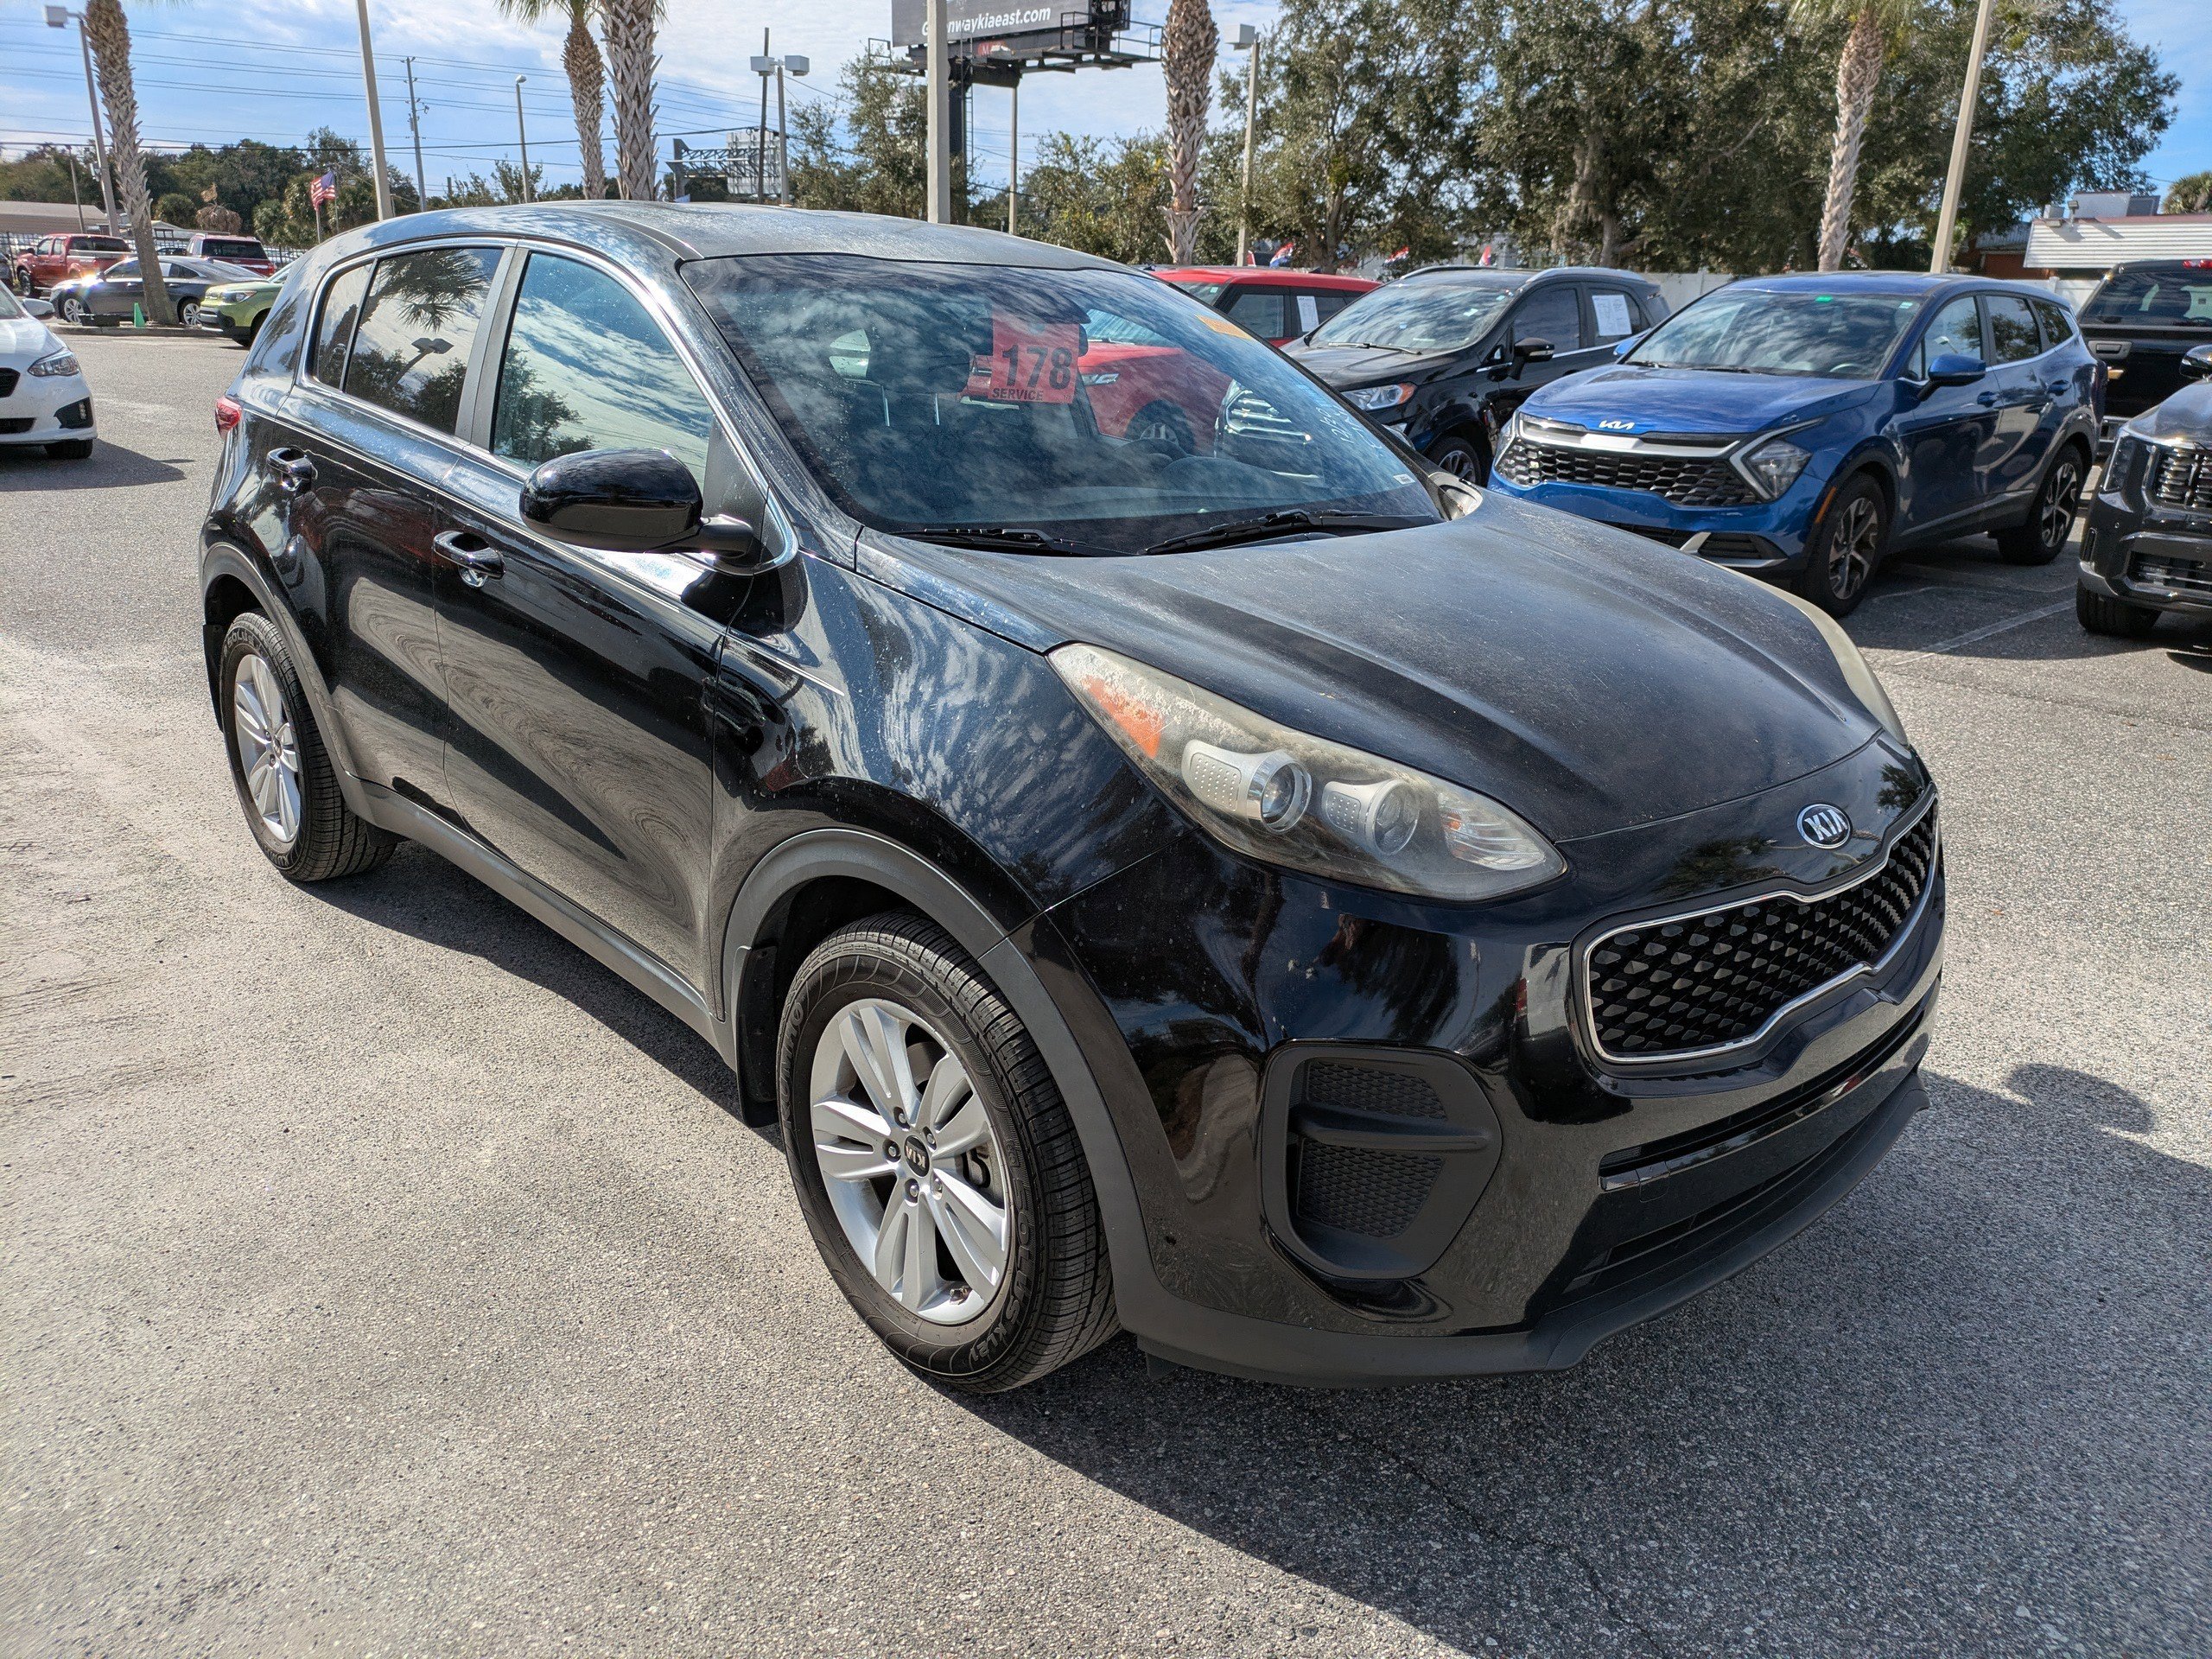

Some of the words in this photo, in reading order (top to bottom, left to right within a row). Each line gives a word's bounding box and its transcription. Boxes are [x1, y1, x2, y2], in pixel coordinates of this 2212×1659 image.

[1002, 345, 1072, 389] 178
[992, 388, 1044, 401] SERVICE
[1599, 420, 1636, 430] KIA
[1804, 809, 1848, 841] KIA
[906, 1145, 926, 1169] KIA
